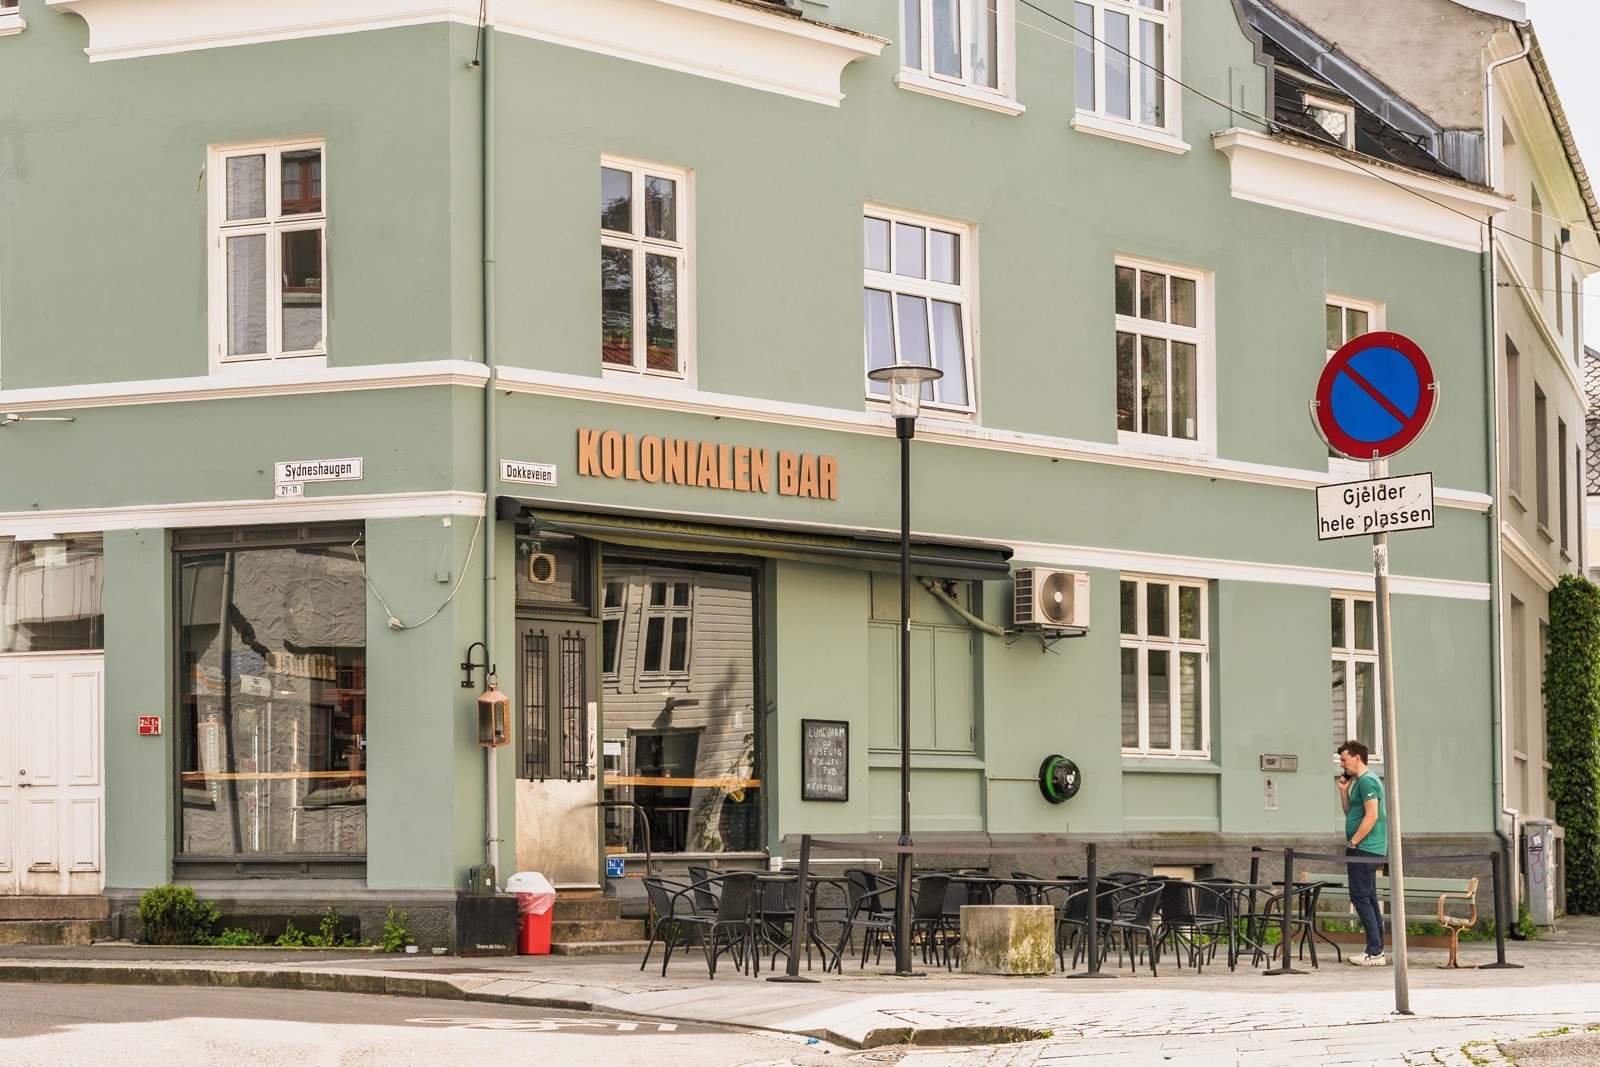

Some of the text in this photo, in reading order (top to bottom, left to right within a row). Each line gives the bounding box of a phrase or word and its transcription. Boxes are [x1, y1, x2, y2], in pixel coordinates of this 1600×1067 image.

[285, 463, 352, 480] Sydneshaugen
[506, 464, 552, 481] Dokkeveien
[578, 428, 838, 500] KOLONIALEN BAR
[1343, 484, 1406, 508] Gjelder
[1320, 508, 1431, 533] hele plassen
